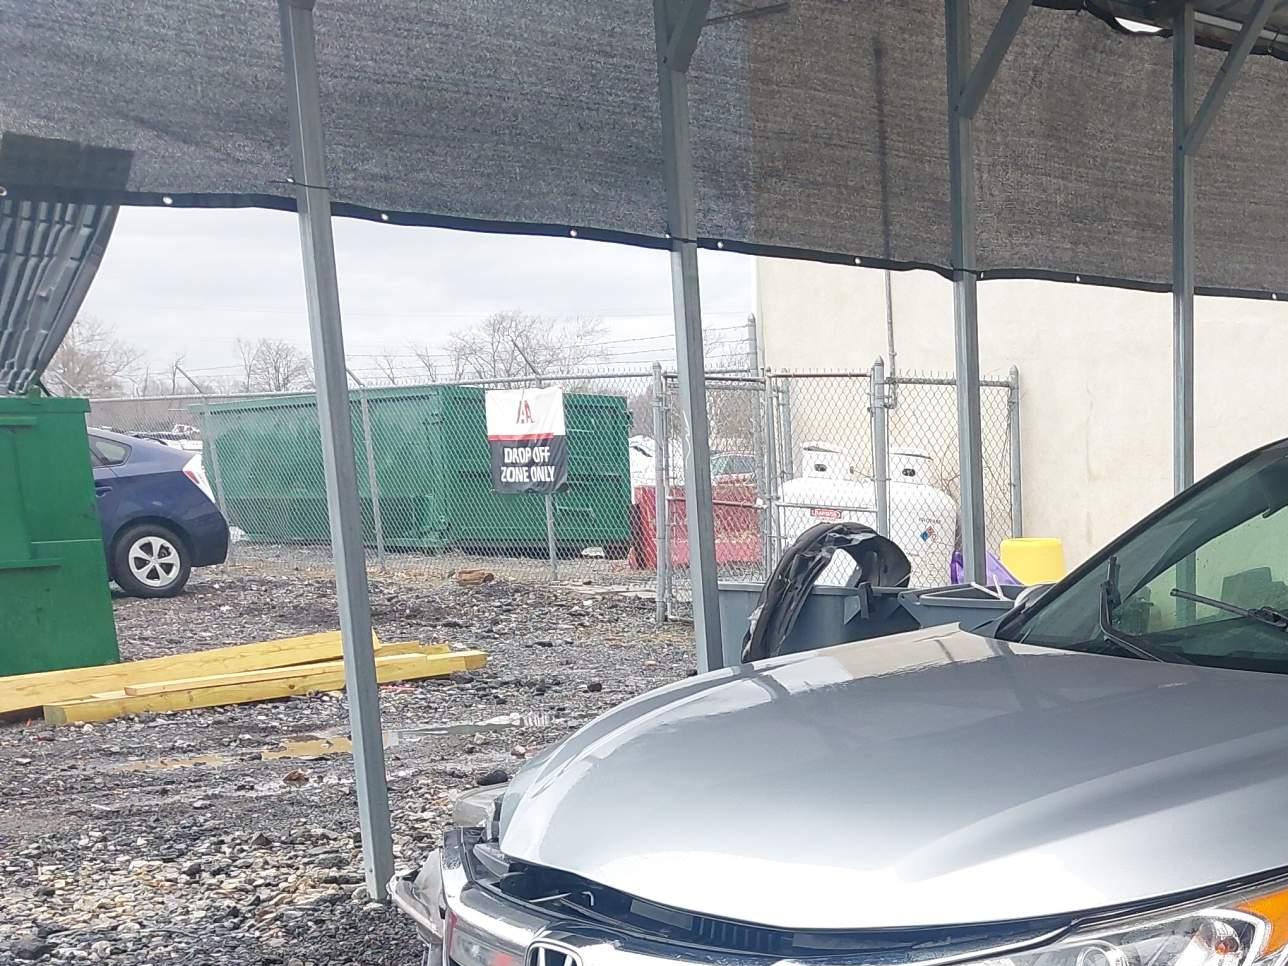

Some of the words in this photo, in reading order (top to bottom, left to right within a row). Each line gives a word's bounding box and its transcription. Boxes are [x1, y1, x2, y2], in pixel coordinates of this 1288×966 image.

[504, 448, 531, 463] DROP
[532, 446, 550, 462] OFF
[501, 467, 529, 482] ZONE
[530, 466, 555, 482] ONLY
